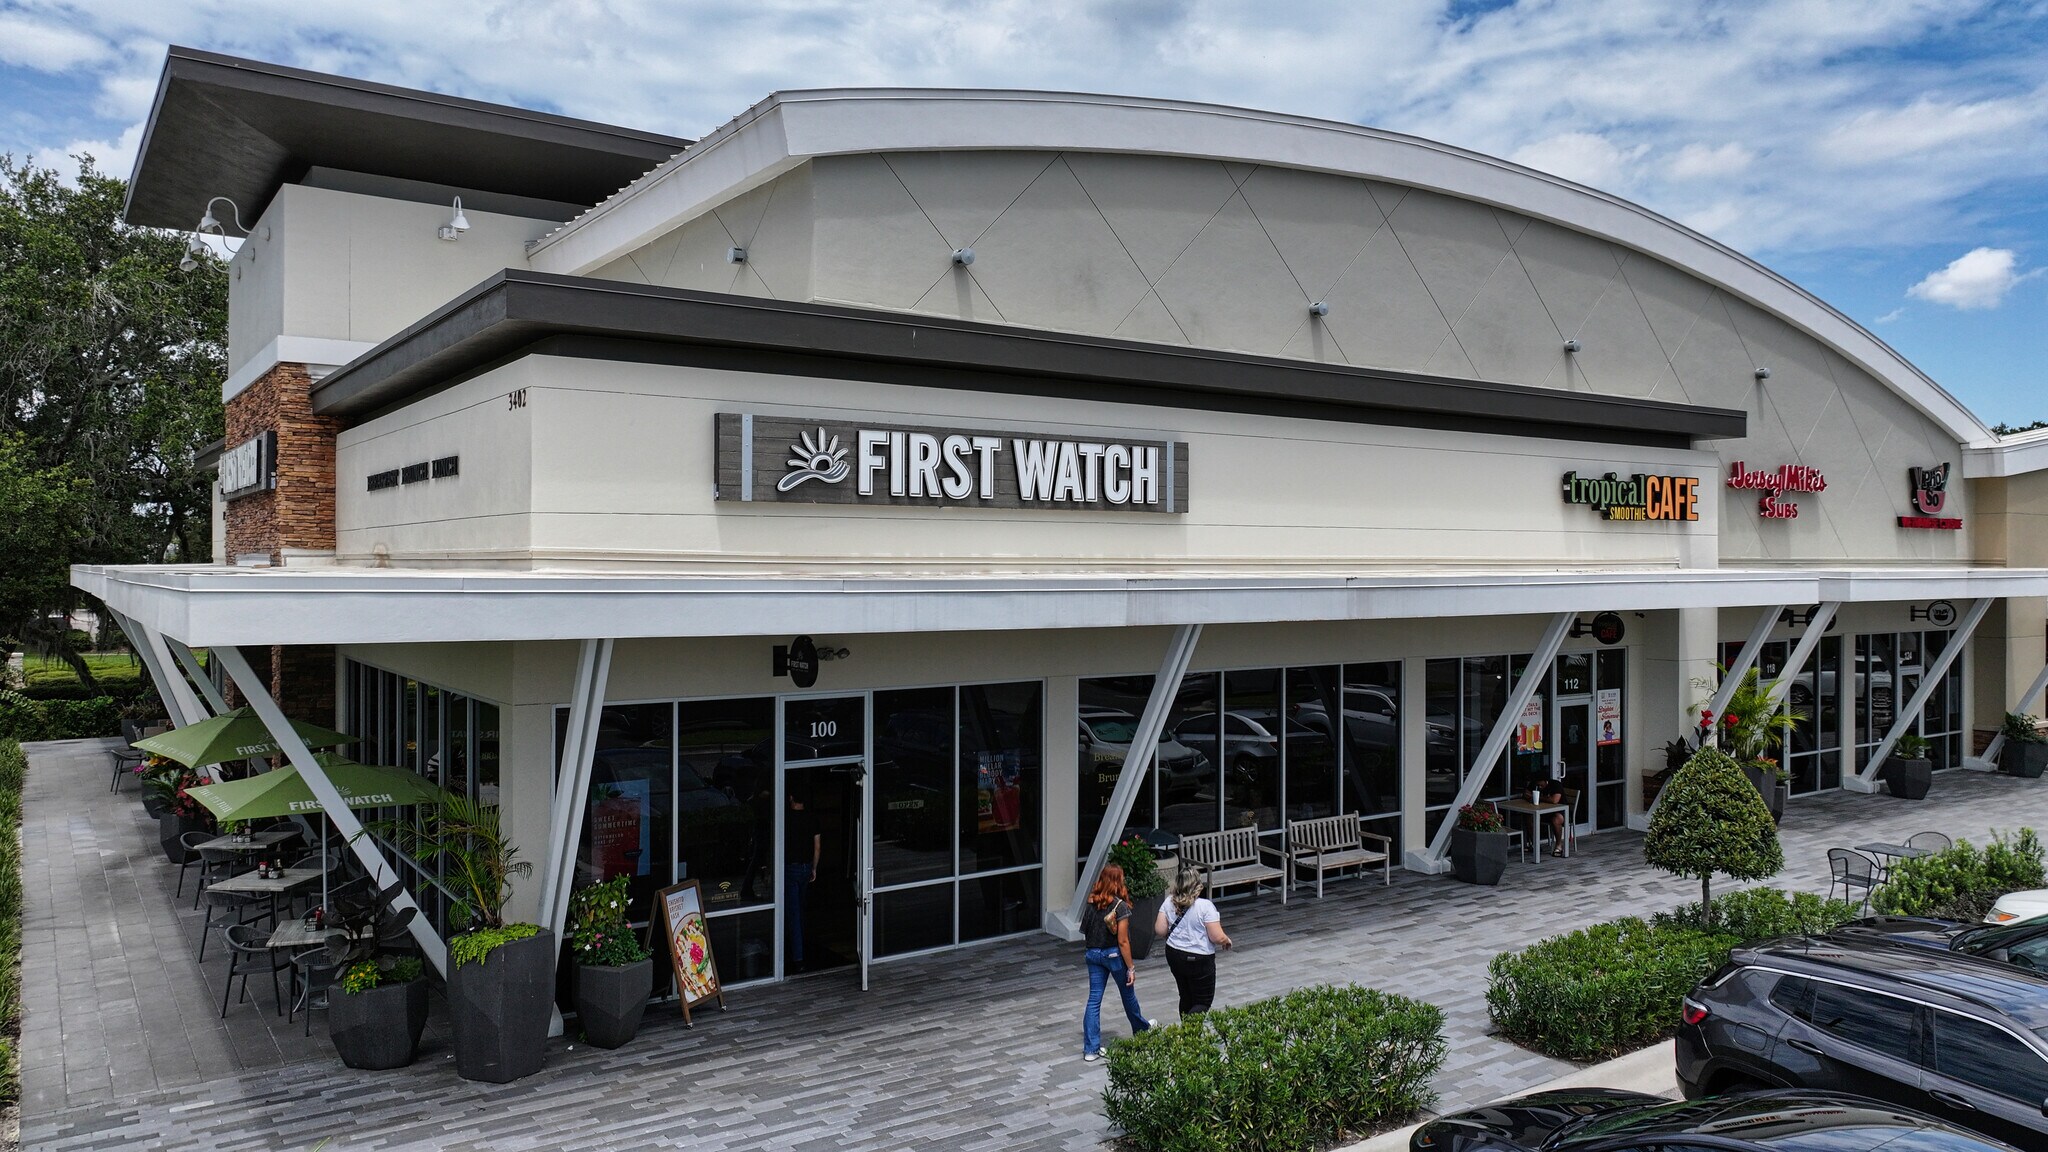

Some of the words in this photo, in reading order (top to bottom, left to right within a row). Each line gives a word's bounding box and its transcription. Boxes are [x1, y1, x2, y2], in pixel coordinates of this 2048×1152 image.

[509, 389, 527, 412] 3402
[431, 455, 459, 479] LUNCH
[857, 430, 1001, 500] FIRST
[1012, 439, 1160, 505] WATCH
[1733, 461, 1783, 498] Jersey
[1569, 473, 1646, 510] tropical
[1609, 507, 1646, 521] SMOOTHIE
[1646, 475, 1699, 521] CAFE
[1925, 490, 1939, 507] So
[1564, 678, 1579, 690] 112
[810, 721, 837, 738] 100
[235, 743, 270, 756] FIRST
[289, 800, 324, 811] FIRS
